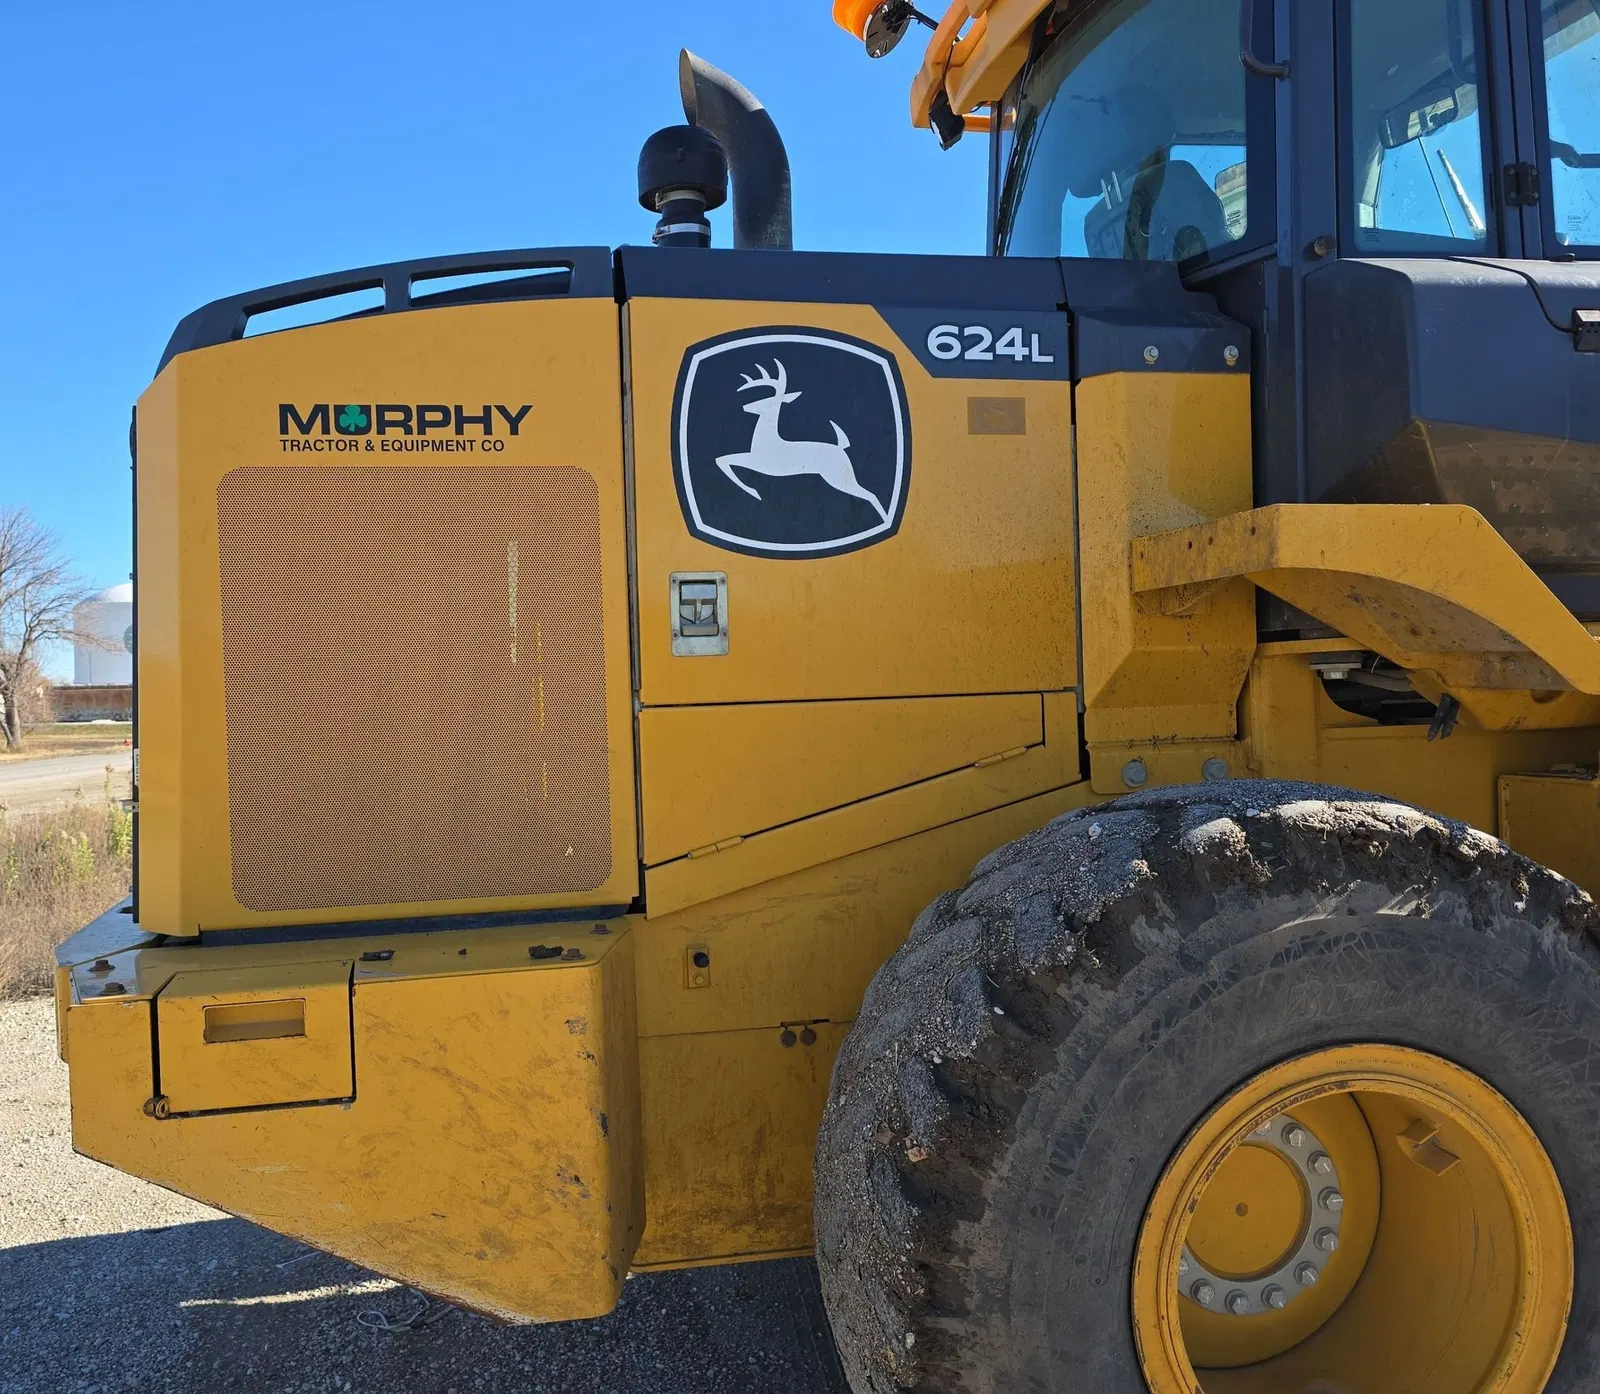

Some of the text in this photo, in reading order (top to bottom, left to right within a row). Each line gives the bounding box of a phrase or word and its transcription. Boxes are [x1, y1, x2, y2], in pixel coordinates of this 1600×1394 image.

[927, 324, 1054, 362] 624L
[278, 403, 533, 436] MURPHY
[279, 439, 505, 452] TRACTOR & EQUIPMENT CO
